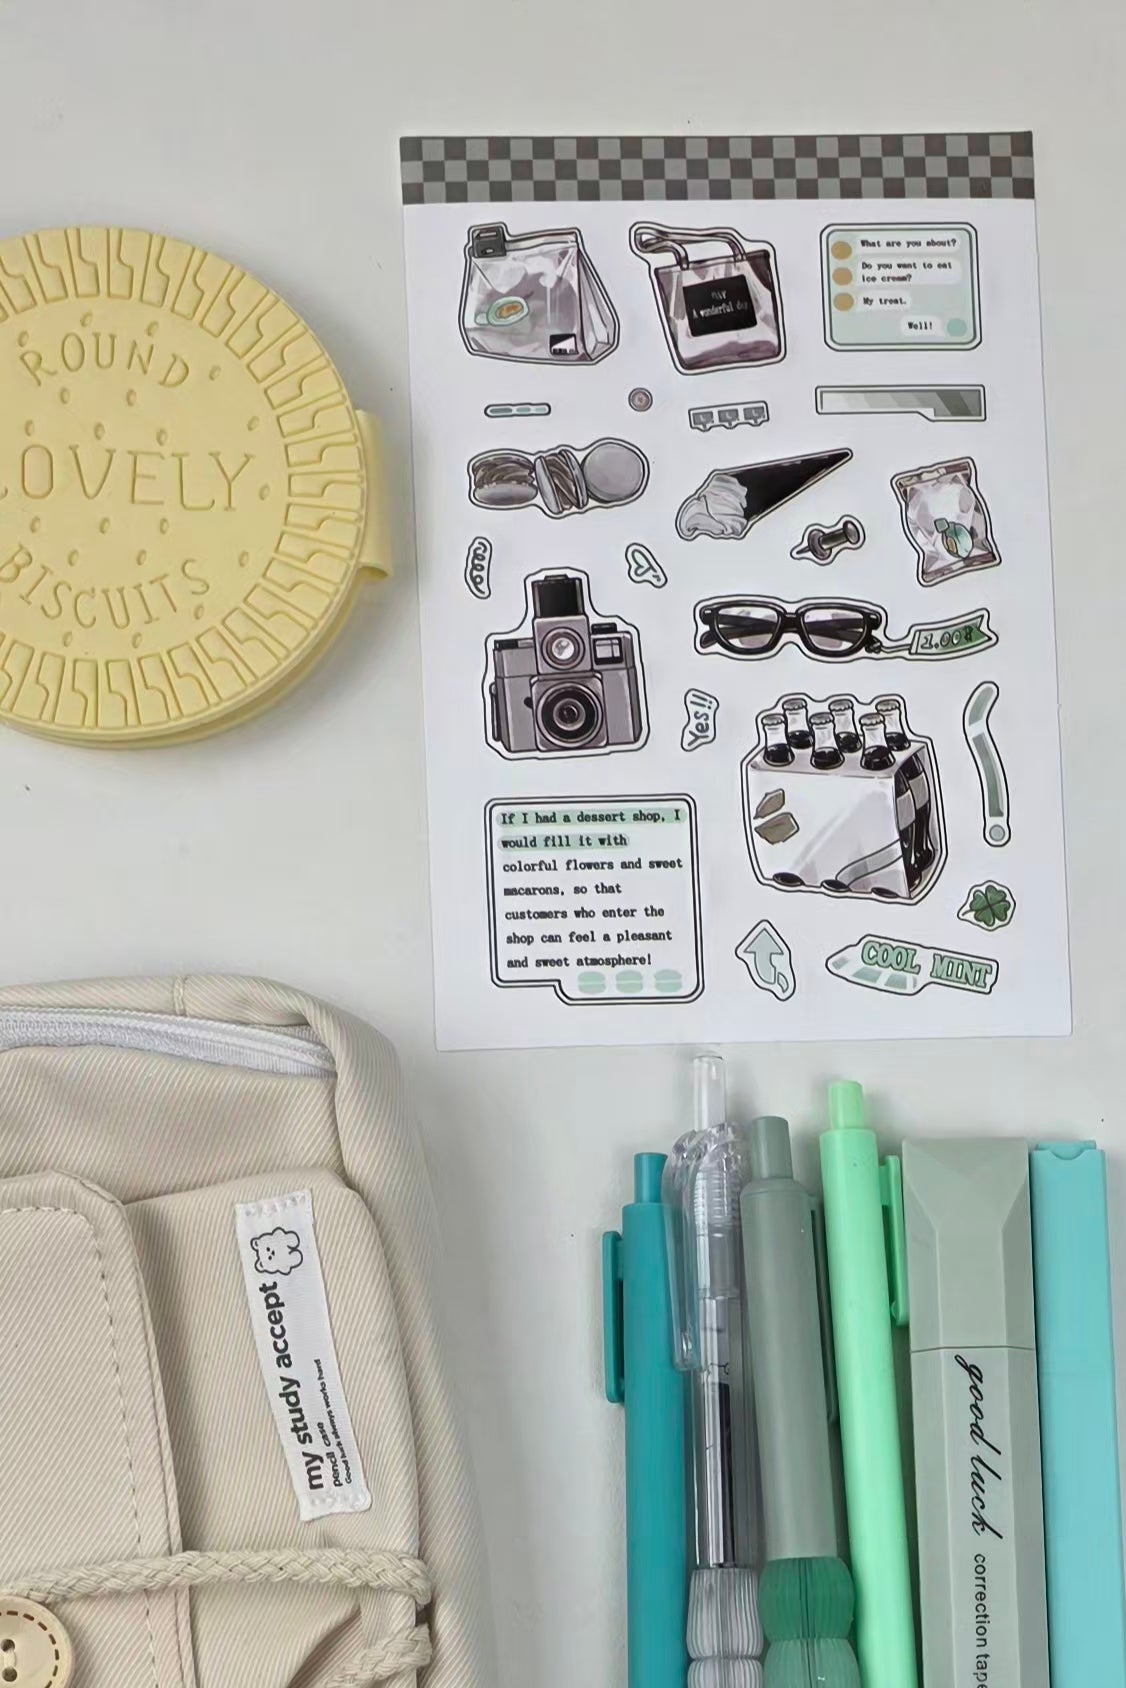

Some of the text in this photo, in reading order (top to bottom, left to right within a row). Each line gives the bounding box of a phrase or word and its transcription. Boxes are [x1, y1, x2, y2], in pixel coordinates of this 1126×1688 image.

[18, 331, 190, 387] ROUND
[0, 444, 255, 511] OVELY
[0, 543, 210, 630] BISCUITS
[688, 693, 712, 746] Yes!!
[502, 813, 515, 824] If
[522, 813, 528, 823] I
[536, 812, 556, 823] had
[563, 815, 571, 823] a
[577, 811, 625, 822] dessert
[674, 809, 680, 821] I
[502, 834, 627, 848] would fill it with
[503, 858, 683, 872] colorful flowers and sweet
[574, 886, 587, 894] so
[595, 883, 622, 894] that
[505, 905, 664, 920] customers who enter the
[506, 930, 672, 945] shop can feel a pleasant
[507, 954, 651, 968] and sweet atmosphere!
[862, 940, 993, 988] COOL MINT
[259, 1281, 324, 1490] my study accept
[317, 1422, 343, 1487] pencil case
[954, 1354, 1003, 1540] good luck
[973, 1553, 988, 1649] correction
